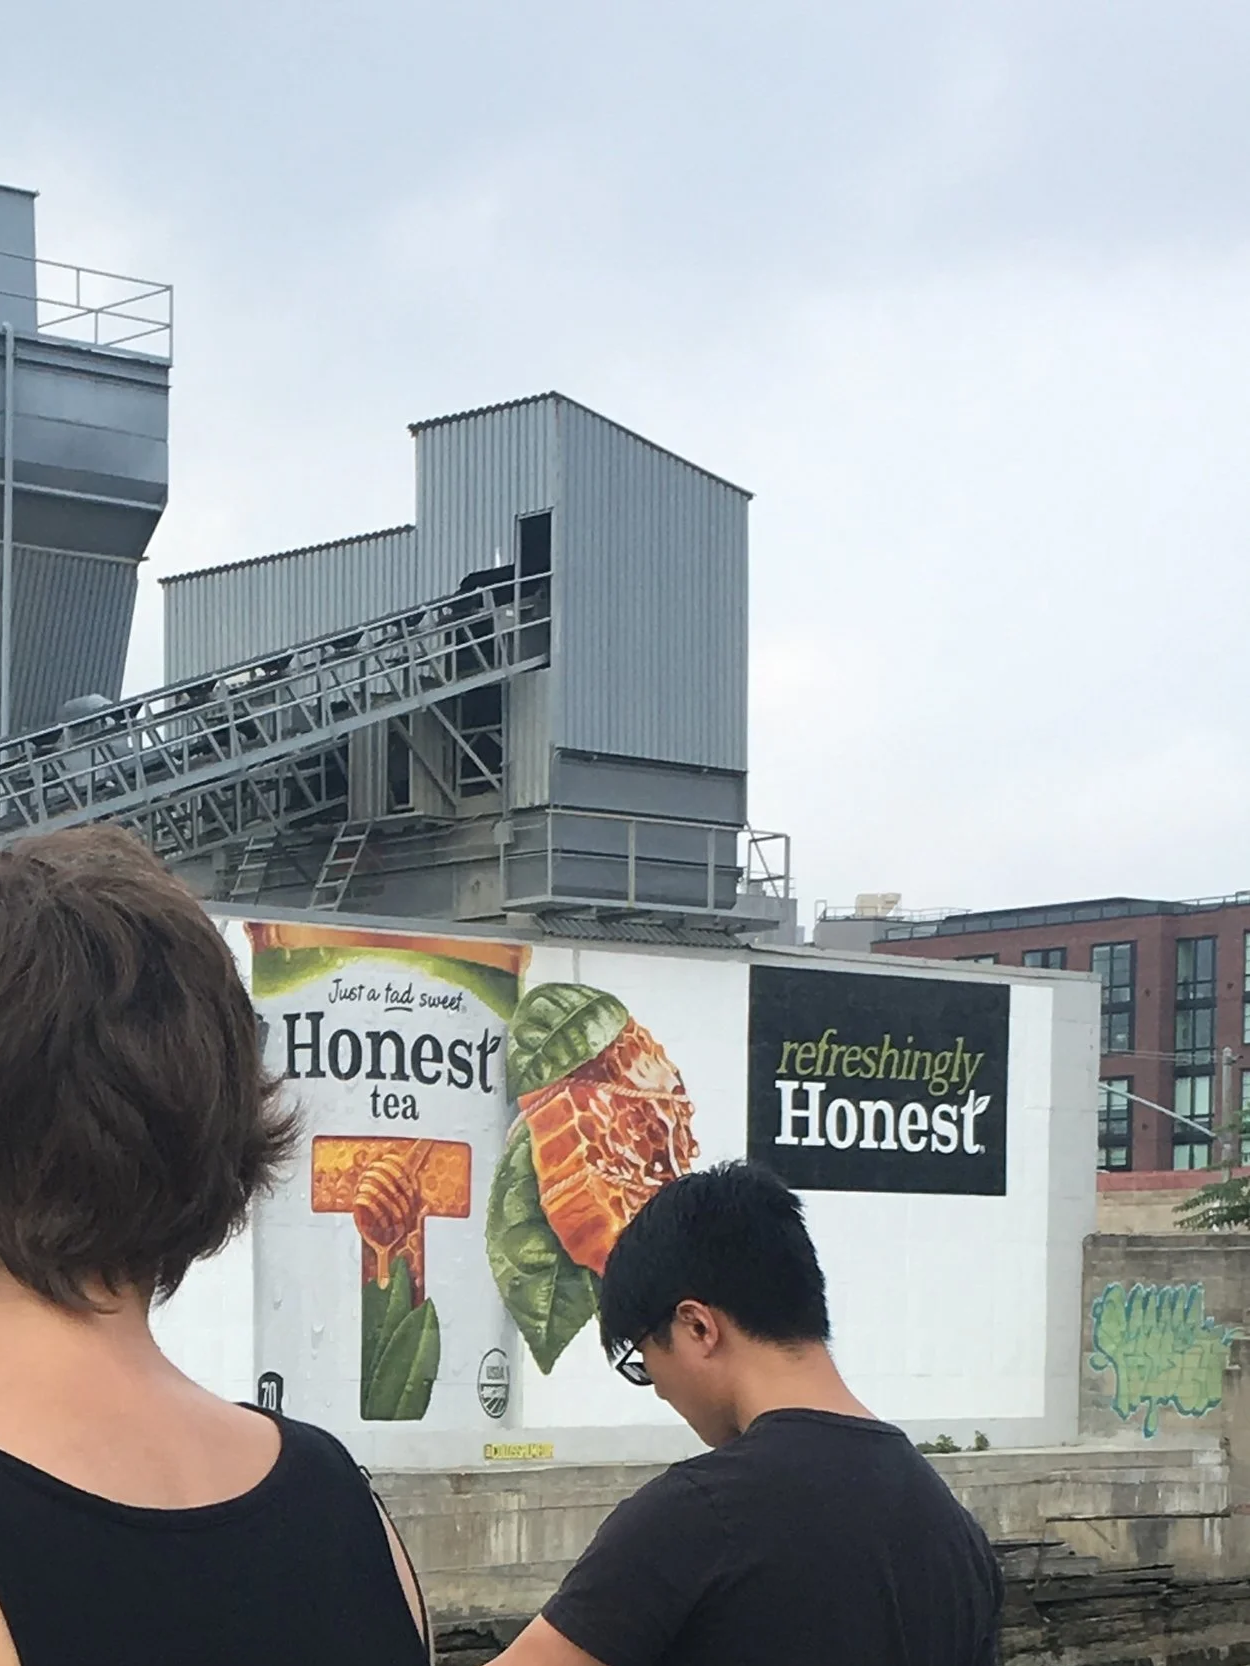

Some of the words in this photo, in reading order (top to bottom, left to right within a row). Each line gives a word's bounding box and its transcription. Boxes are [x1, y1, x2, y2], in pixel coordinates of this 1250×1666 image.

[328, 979, 366, 1004] Just
[366, 987, 381, 1001] a
[384, 982, 414, 1004] tad
[419, 991, 463, 1011] sweet
[283, 1011, 502, 1093] Honest
[776, 1028, 985, 1096] refreshingly
[370, 1085, 420, 1121] tea
[774, 1079, 992, 1155] Honest
[261, 1381, 277, 1411] 70
